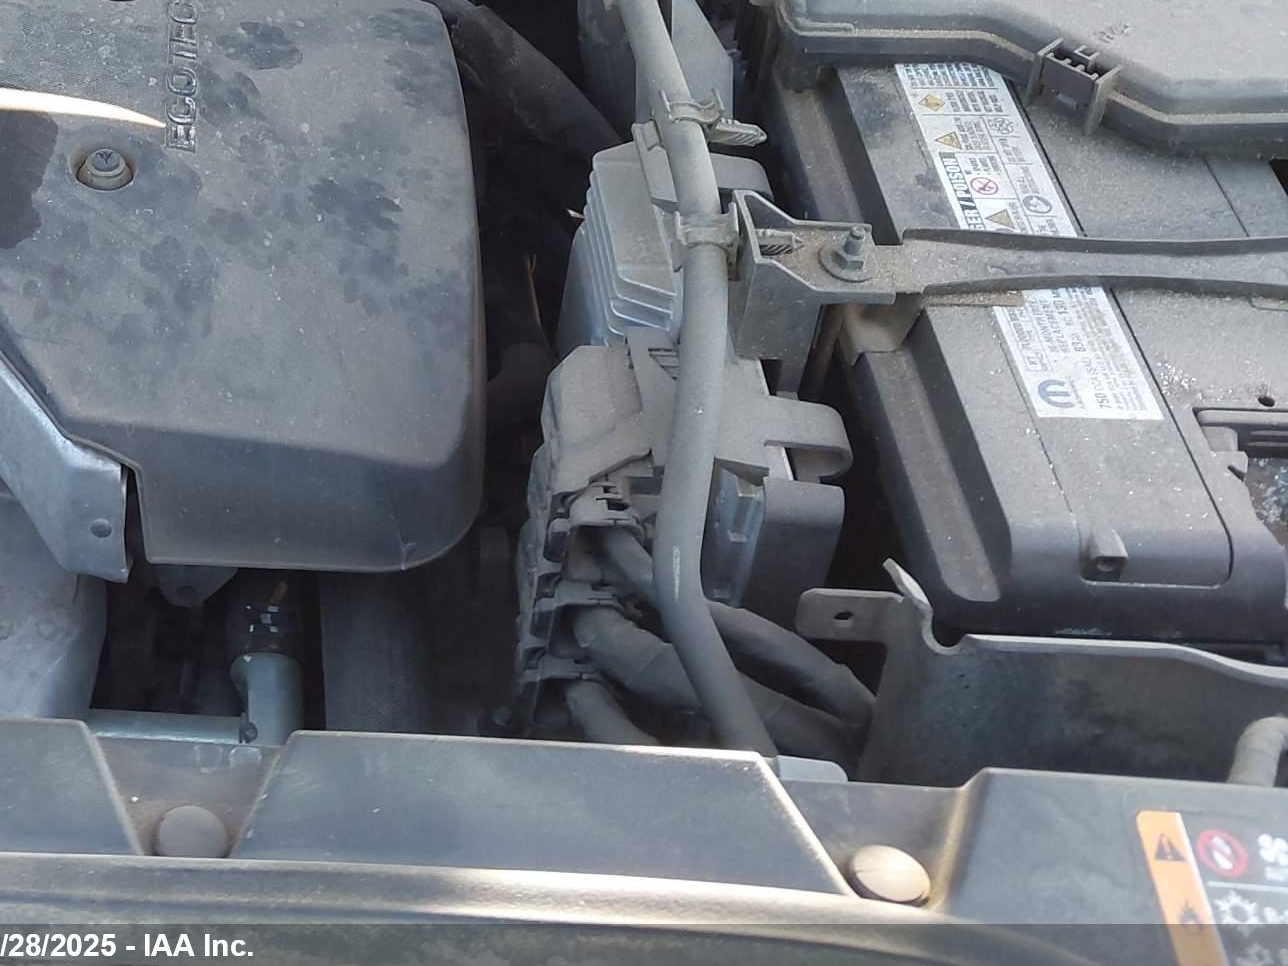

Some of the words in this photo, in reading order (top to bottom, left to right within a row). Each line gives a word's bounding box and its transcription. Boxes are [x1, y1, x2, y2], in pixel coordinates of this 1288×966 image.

[165, 0, 199, 153] ECOTEC
[941, 157, 971, 197] POISON
[963, 209, 984, 231] GER
